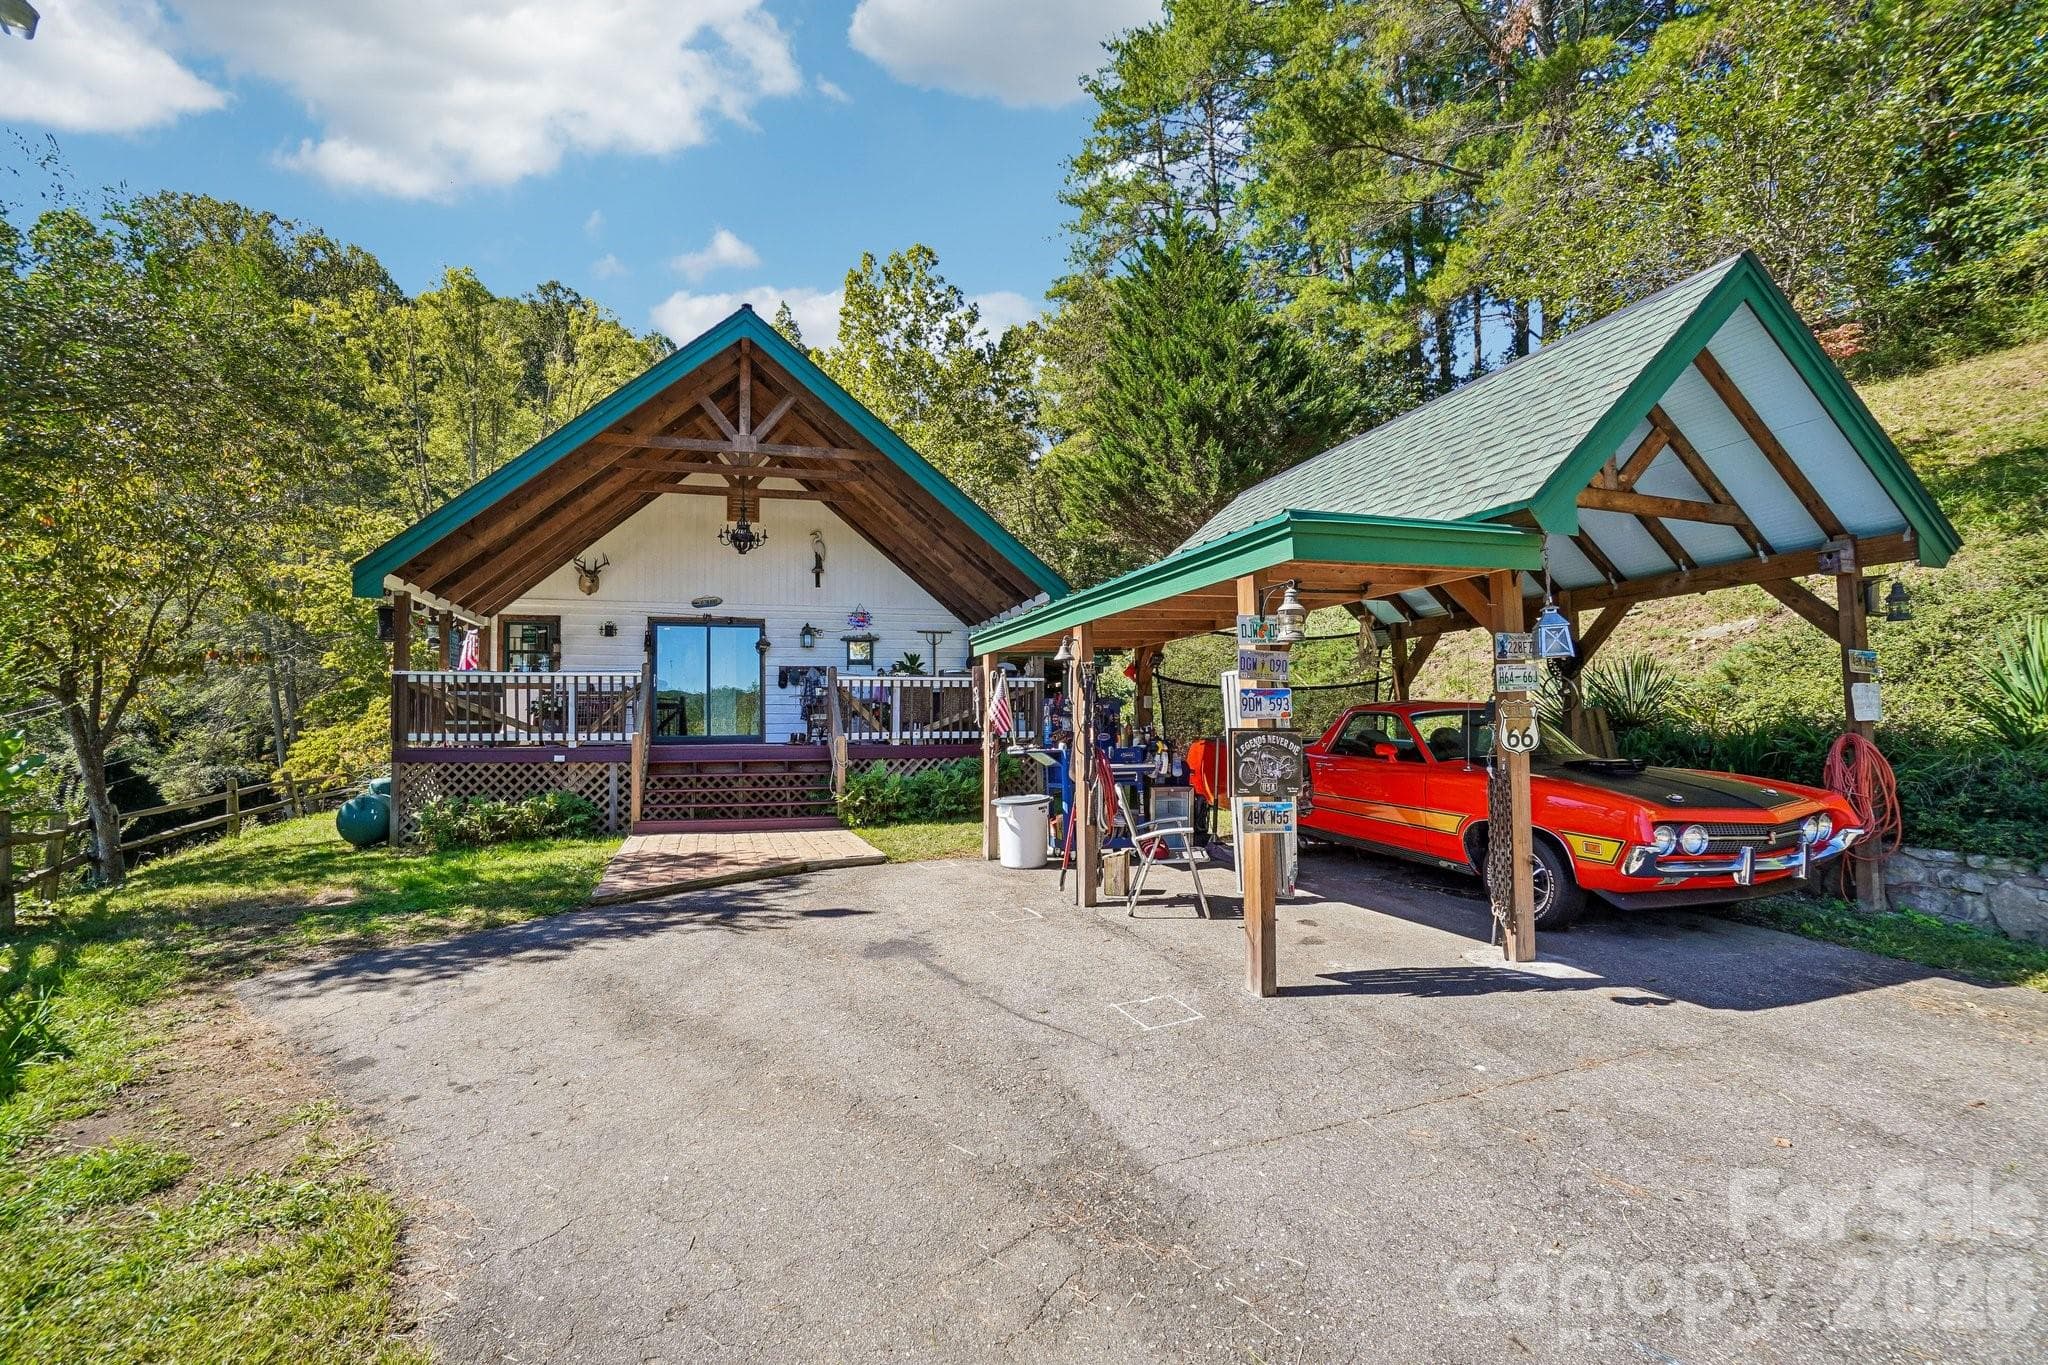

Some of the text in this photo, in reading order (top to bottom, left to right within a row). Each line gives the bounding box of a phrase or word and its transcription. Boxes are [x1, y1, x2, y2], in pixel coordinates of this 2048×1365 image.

[1270, 659, 1287, 673] 090
[1241, 697, 1290, 712] 9DM 593
[1508, 727, 1533, 748] 66
[1235, 735, 1301, 757] LEGENDS NEVER DIE
[1247, 810, 1266, 825] 49K
